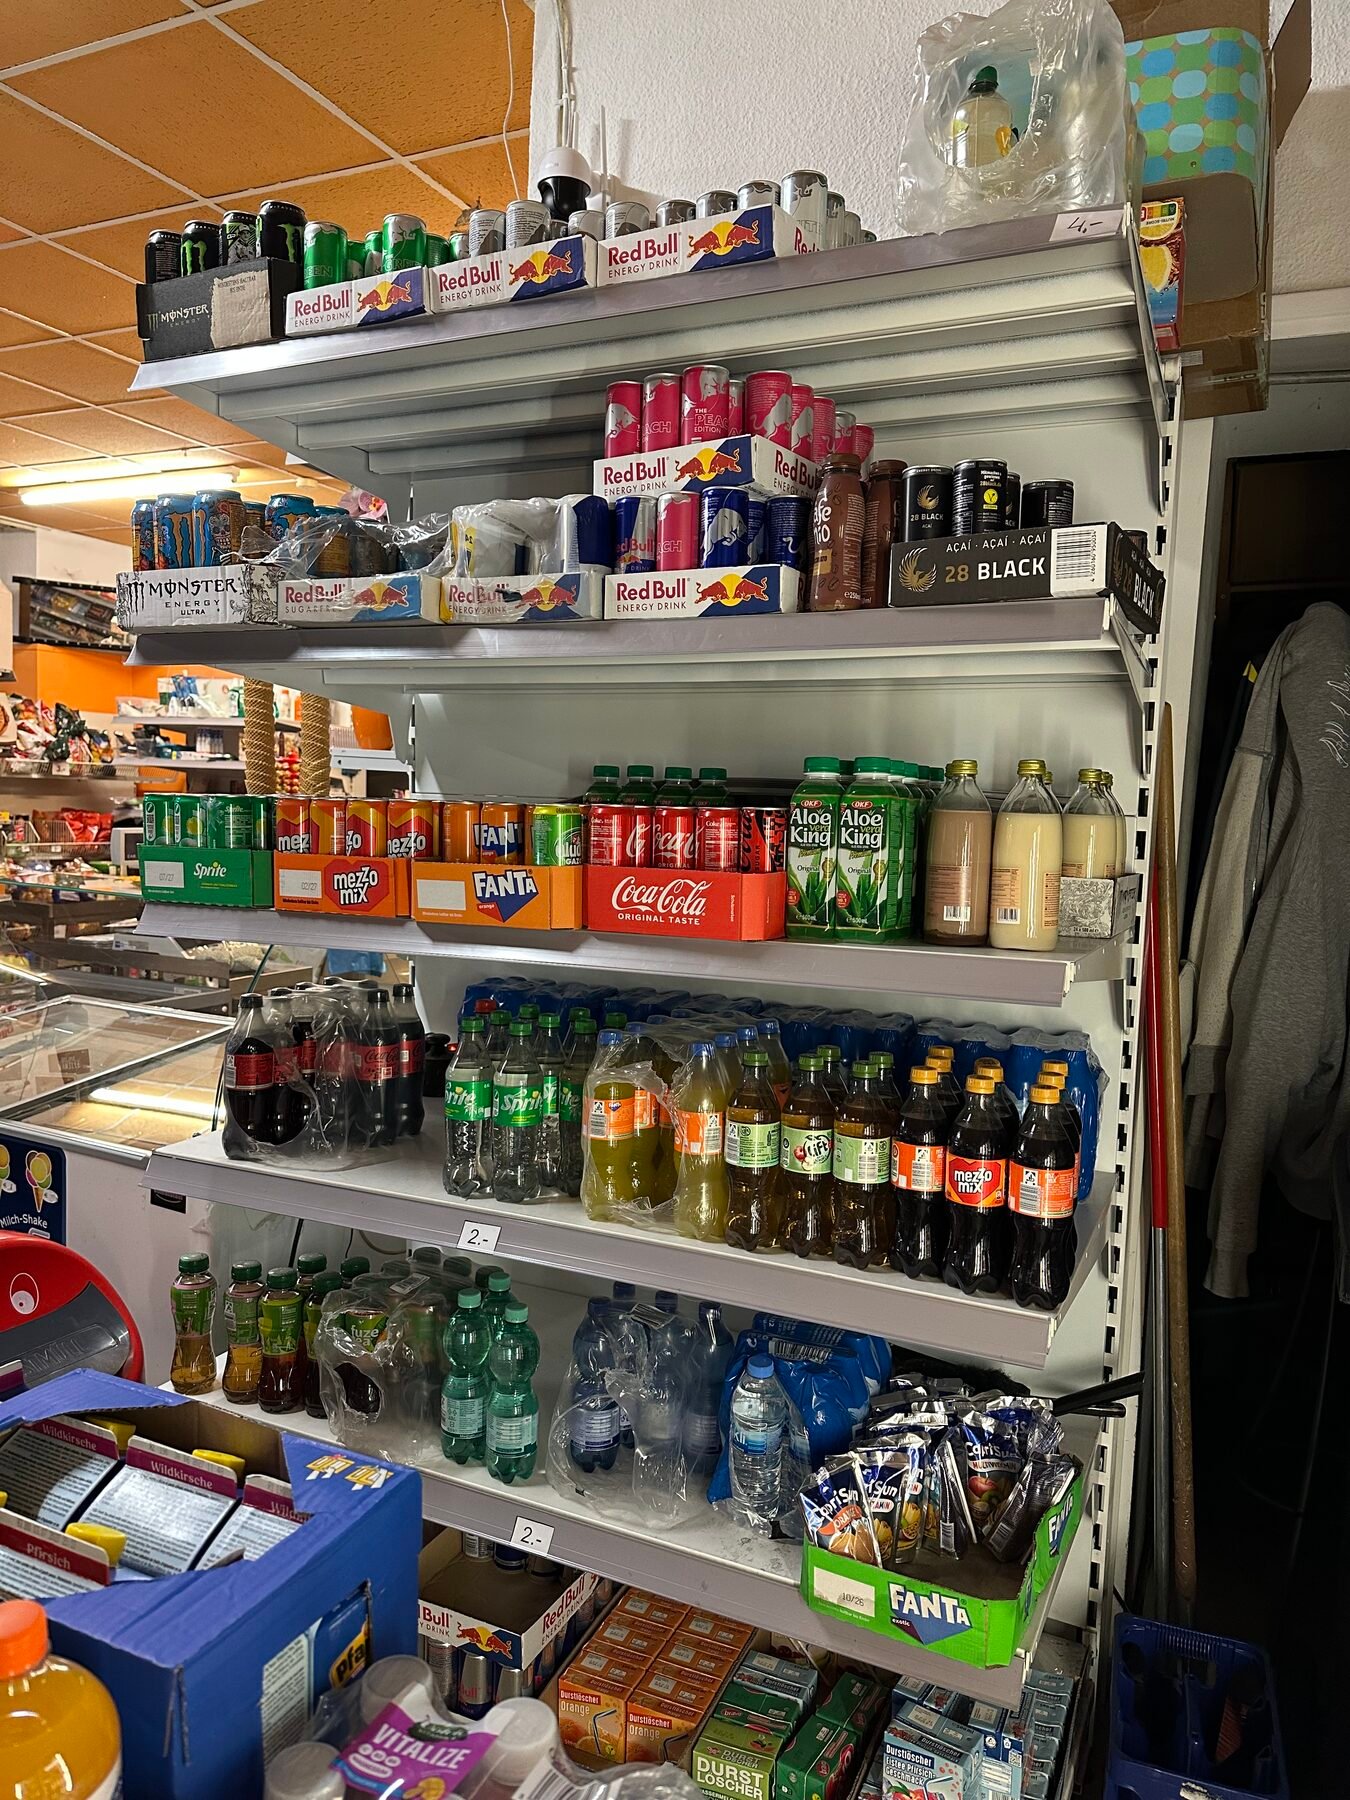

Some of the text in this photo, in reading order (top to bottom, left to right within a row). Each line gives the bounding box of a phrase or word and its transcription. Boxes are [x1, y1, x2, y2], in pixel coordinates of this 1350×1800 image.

[608, 233, 678, 266] Red Bull
[439, 261, 500, 292] Red Bull
[608, 257, 679, 278] ENERGY DRINK
[295, 290, 350, 317] Red Bull
[440, 283, 501, 304] ENERGY DRINK
[295, 311, 350, 328] ENERGY DRINK
[604, 457, 666, 486] Red Bull
[774, 449, 796, 481] Red
[604, 480, 667, 496] ENERGY DRINK
[921, 512, 944, 521] BLACK
[946, 531, 1047, 553] AÇAÍ AÇAÍ AÇAÍ
[945, 557, 1046, 584] 28 BLACK
[285, 586, 344, 603] Red Bull
[449, 585, 476, 603] Red
[617, 578, 685, 601] Red Bull
[1133, 572, 1155, 618] BLACK
[165, 599, 220, 608] ENERGY
[449, 605, 479, 614] ENERGY
[617, 601, 687, 612] ENERGY DRINK
[790, 808, 832, 825] Aloe
[840, 809, 882, 826] Aloe
[480, 821, 523, 847] FANT
[790, 825, 831, 847] King
[809, 824, 830, 832] vera
[841, 827, 882, 848] King
[860, 826, 881, 834] vera
[194, 862, 227, 879] Sprite
[333, 865, 379, 890] mezzo
[796, 864, 820, 873] Original
[847, 866, 871, 875] Original
[473, 870, 538, 898] FANTA
[611, 875, 713, 916] Coca-Cola
[617, 912, 701, 926] ORIGINAL TASTE
[958, 1181, 982, 1194] mix
[0, 1213, 48, 1229] Milch-Shake
[467, 1229, 489, 1246] 2.-
[351, 1325, 379, 1338] fuze
[42, 1423, 97, 1451] Wildkirsche
[150, 1460, 213, 1490] Wildkirsche
[875, 1480, 898, 1498] Sun
[520, 1526, 542, 1546] 2.-
[26, 1542, 72, 1570] Pfirsich
[542, 1575, 586, 1633] Red Bull
[841, 1592, 865, 1607] 10/26
[889, 1582, 972, 1627] FANTA
[422, 1606, 450, 1628] Bull
[541, 1597, 585, 1645] ENERGY DRINK
[892, 1617, 911, 1627] exotic
[426, 1624, 451, 1638] DRINK
[560, 1690, 600, 1705] Durstlöscher
[560, 1700, 590, 1716] Orange
[629, 1713, 670, 1729] Durstlöscher
[629, 1724, 660, 1740] Orange
[373, 1723, 471, 1769] VITALIZE
[886, 1744, 932, 1767] Durstlöscher
[698, 1757, 764, 1788] DURST
[885, 1767, 925, 1785] Geschmack
[886, 1756, 936, 1779] Eistee Pfirsich-
[697, 1770, 763, 1800] LÖSCHER
